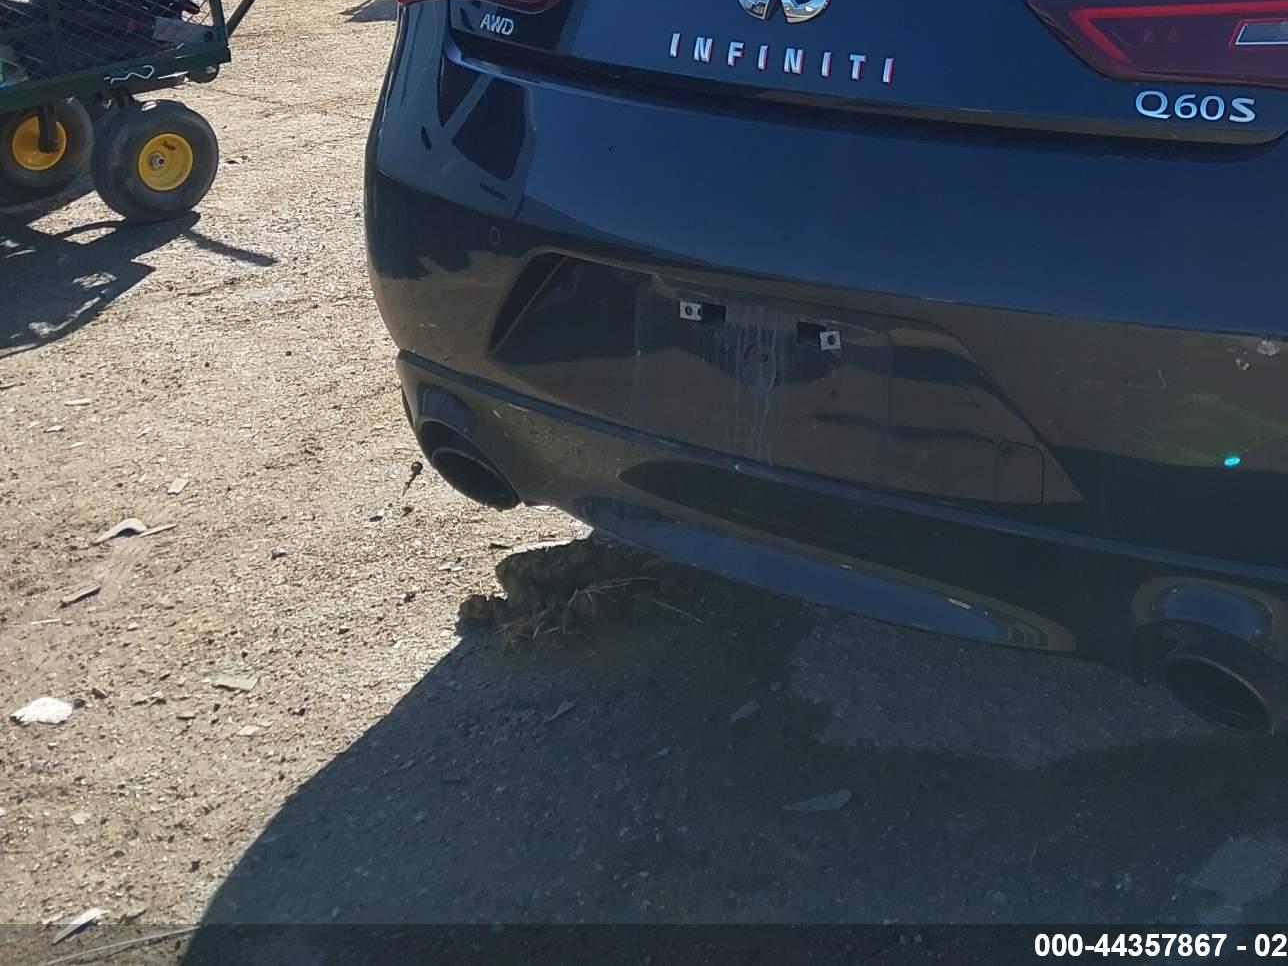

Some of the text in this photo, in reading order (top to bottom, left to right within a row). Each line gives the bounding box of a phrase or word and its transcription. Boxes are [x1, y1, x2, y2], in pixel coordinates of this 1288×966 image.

[480, 14, 514, 35] AWD
[669, 33, 894, 83] INFINITI
[1135, 91, 1256, 123] Q60S
